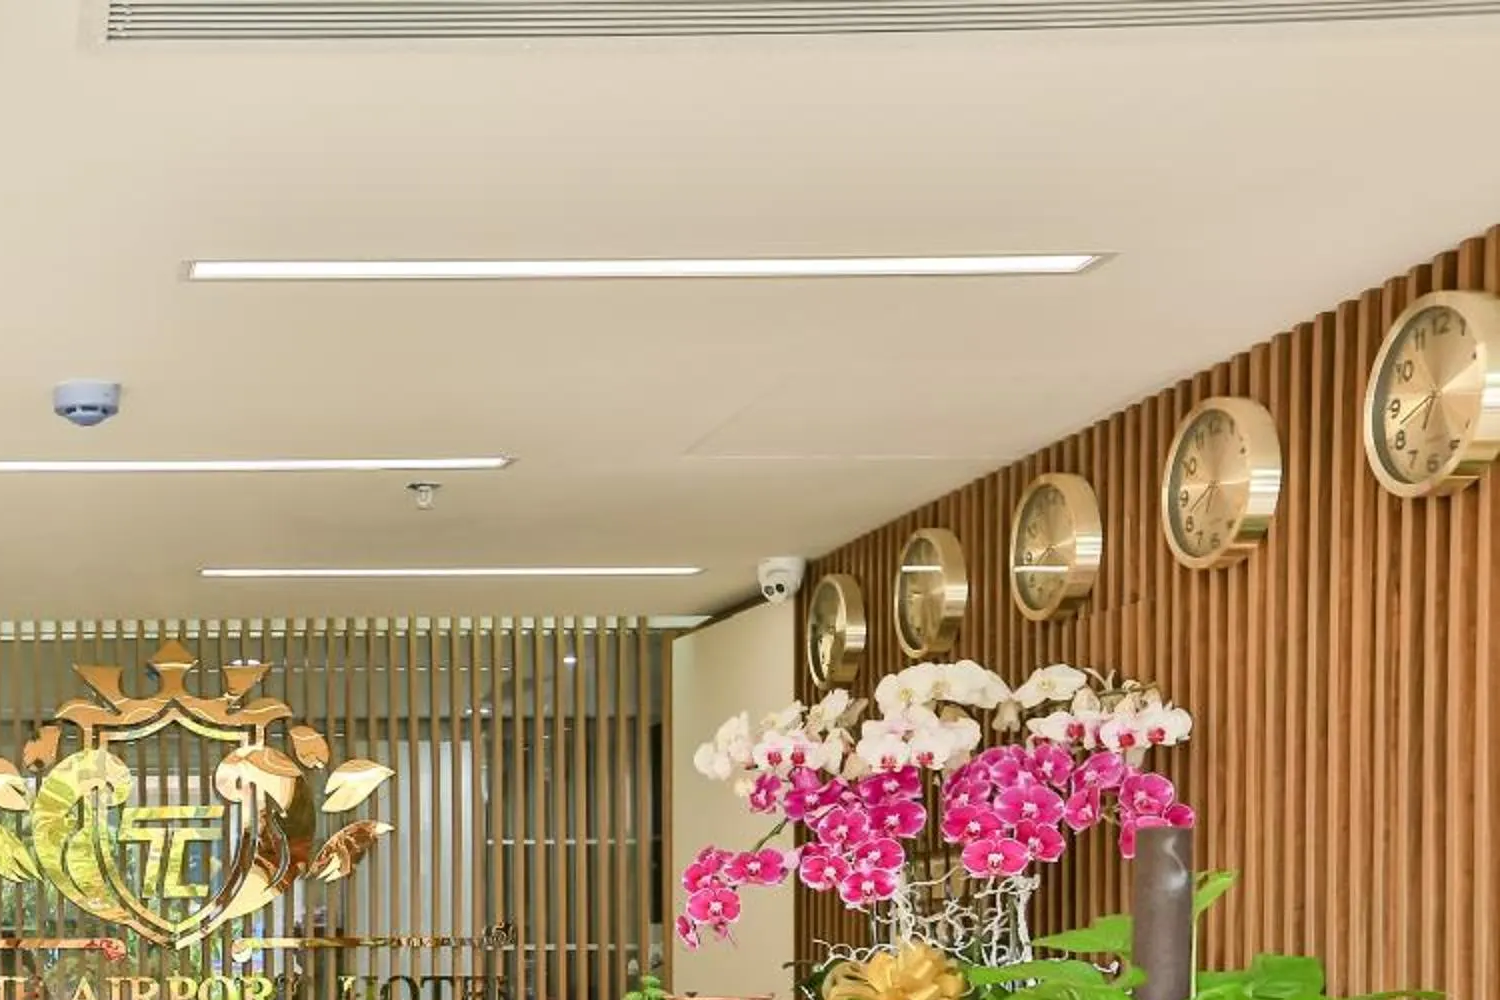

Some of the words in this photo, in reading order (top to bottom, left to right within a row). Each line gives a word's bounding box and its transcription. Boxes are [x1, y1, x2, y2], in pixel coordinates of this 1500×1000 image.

[1432, 313, 1451, 336] 12
[1414, 327, 1426, 352] 11
[1395, 359, 1414, 382] 10
[1391, 398, 1401, 419] 9
[1395, 429, 1406, 450] 8
[1408, 449, 1418, 469] 7
[1426, 453, 1440, 474] 6
